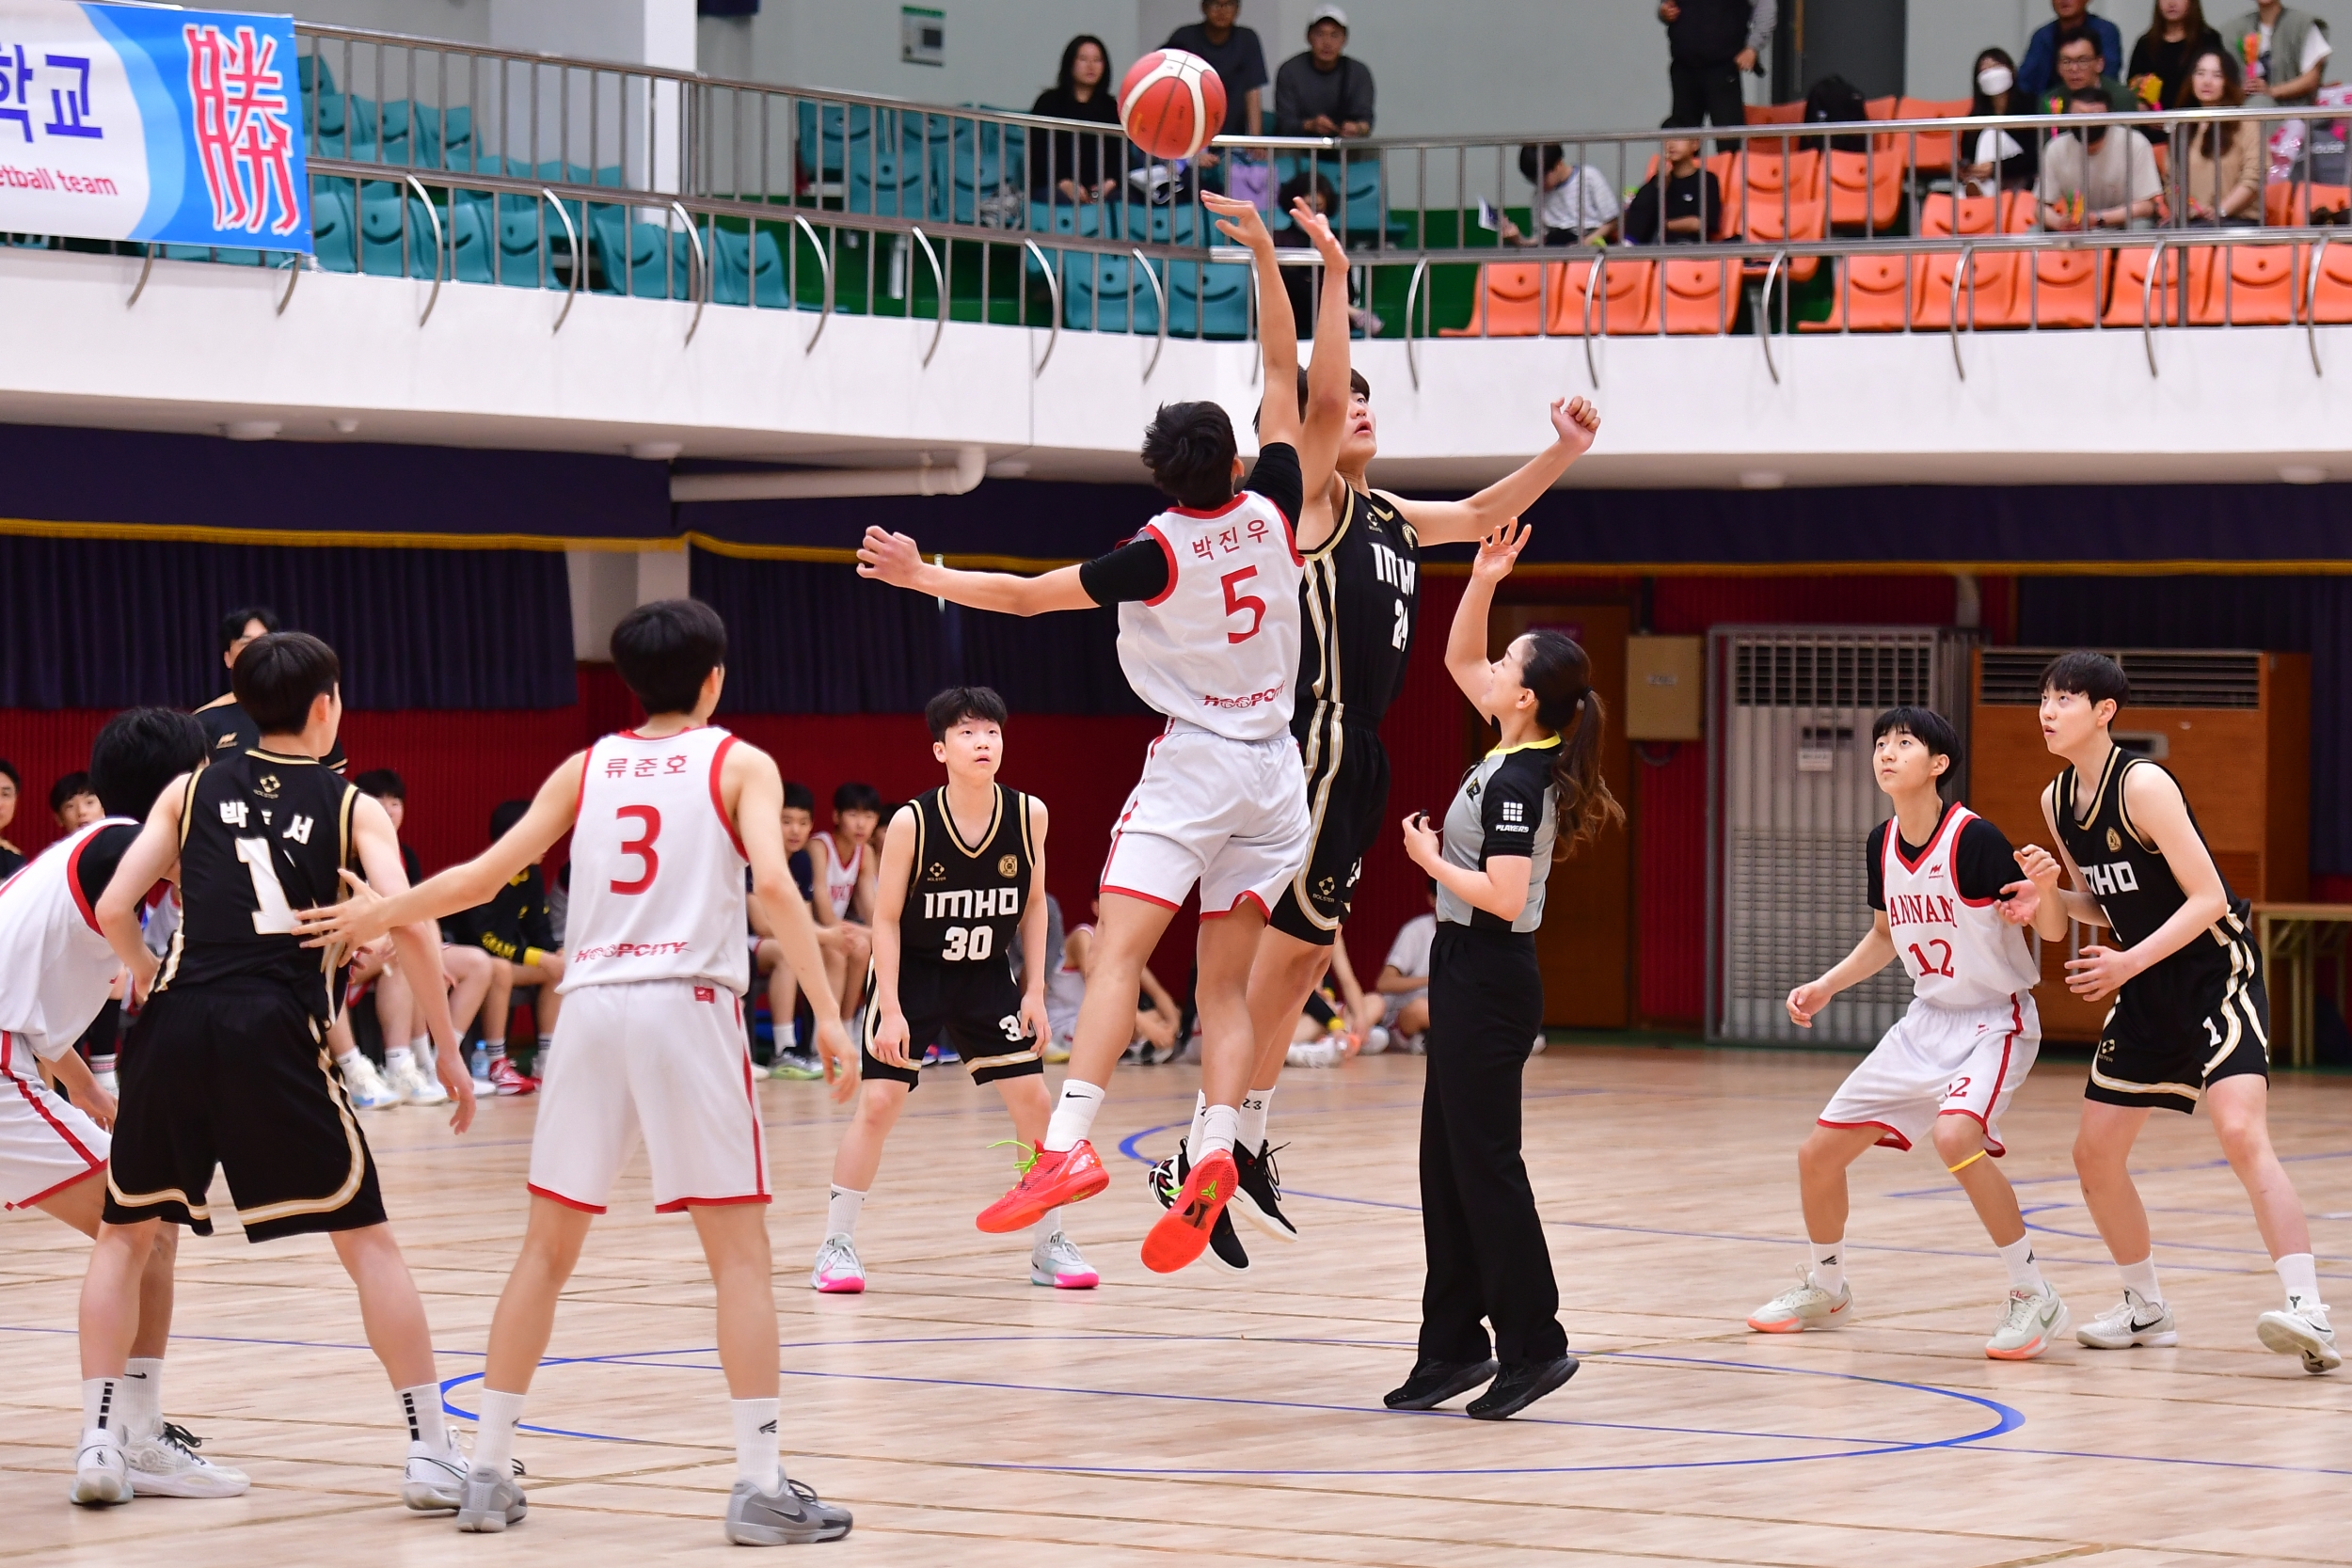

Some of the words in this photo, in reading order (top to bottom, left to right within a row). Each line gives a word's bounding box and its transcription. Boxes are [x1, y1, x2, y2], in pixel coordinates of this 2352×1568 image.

[184, 25, 299, 234] 勝
[56, 170, 119, 196] team
[1369, 542, 1416, 597] IMH
[1220, 564, 1267, 644] 5
[604, 754, 688, 779] 류준호
[219, 800, 314, 846] 박서
[1495, 824, 1530, 833] PLAYERS
[610, 804, 662, 896] 3
[924, 886, 1019, 920] IMHO
[942, 925, 993, 962] 30
[1908, 939, 1954, 979] 12
[2202, 1016, 2222, 1048] 1
[1242, 1098, 1263, 1111] 23
